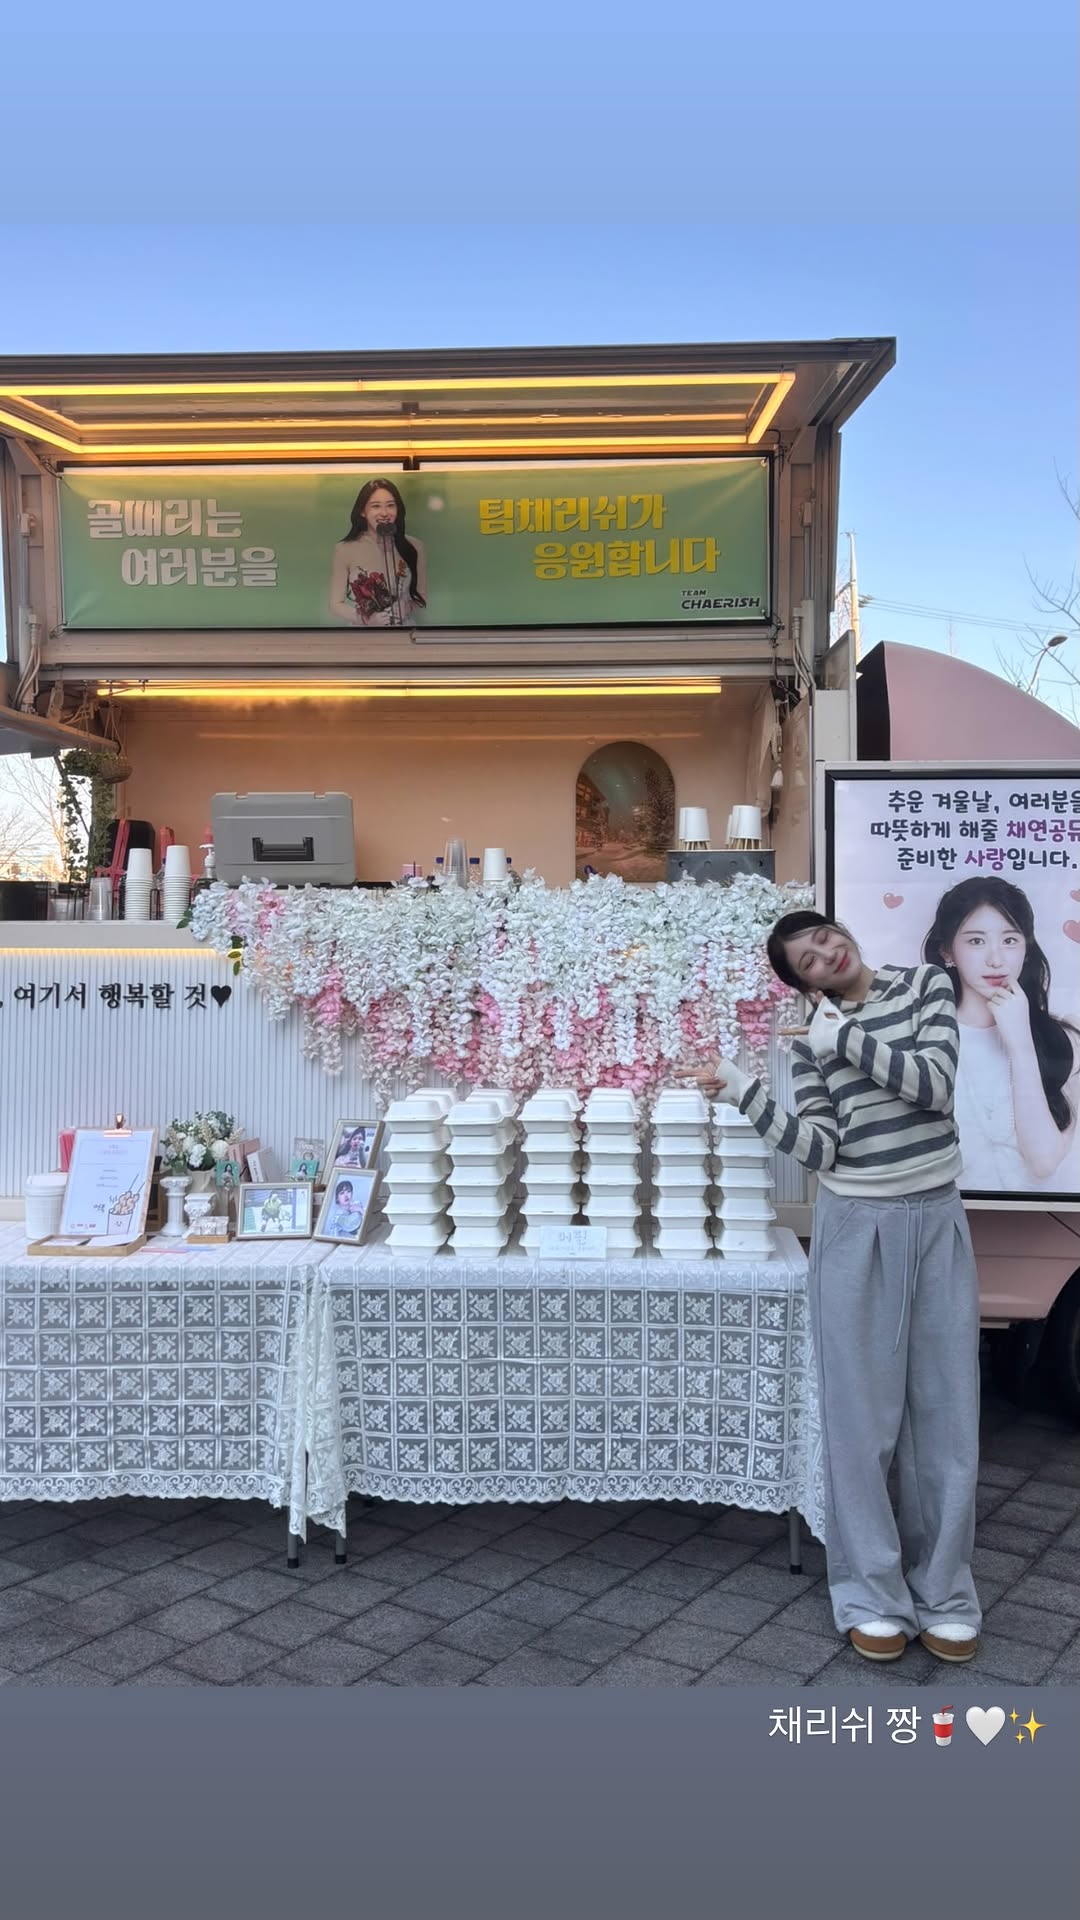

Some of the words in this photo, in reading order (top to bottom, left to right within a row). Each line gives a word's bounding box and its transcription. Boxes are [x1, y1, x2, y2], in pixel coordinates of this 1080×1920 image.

[87, 498, 244, 539] 골때리는
[479, 494, 668, 535] 팀채리쉬가
[121, 546, 279, 587] 여러분을
[532, 536, 721, 580] 응원합니다
[681, 597, 760, 610] CHAERISH
[888, 790, 925, 813] 추운
[932, 790, 1001, 814] 겨울날,
[870, 818, 951, 842] 따뜻하게
[958, 818, 999, 842] 해줄
[897, 847, 958, 871] 준비한
[964, 848, 1078, 871] 사랑입니다.
[13, 982, 87, 1011] 여기서
[98, 982, 175, 1010] 행복할
[184, 983, 208, 1011] 것
